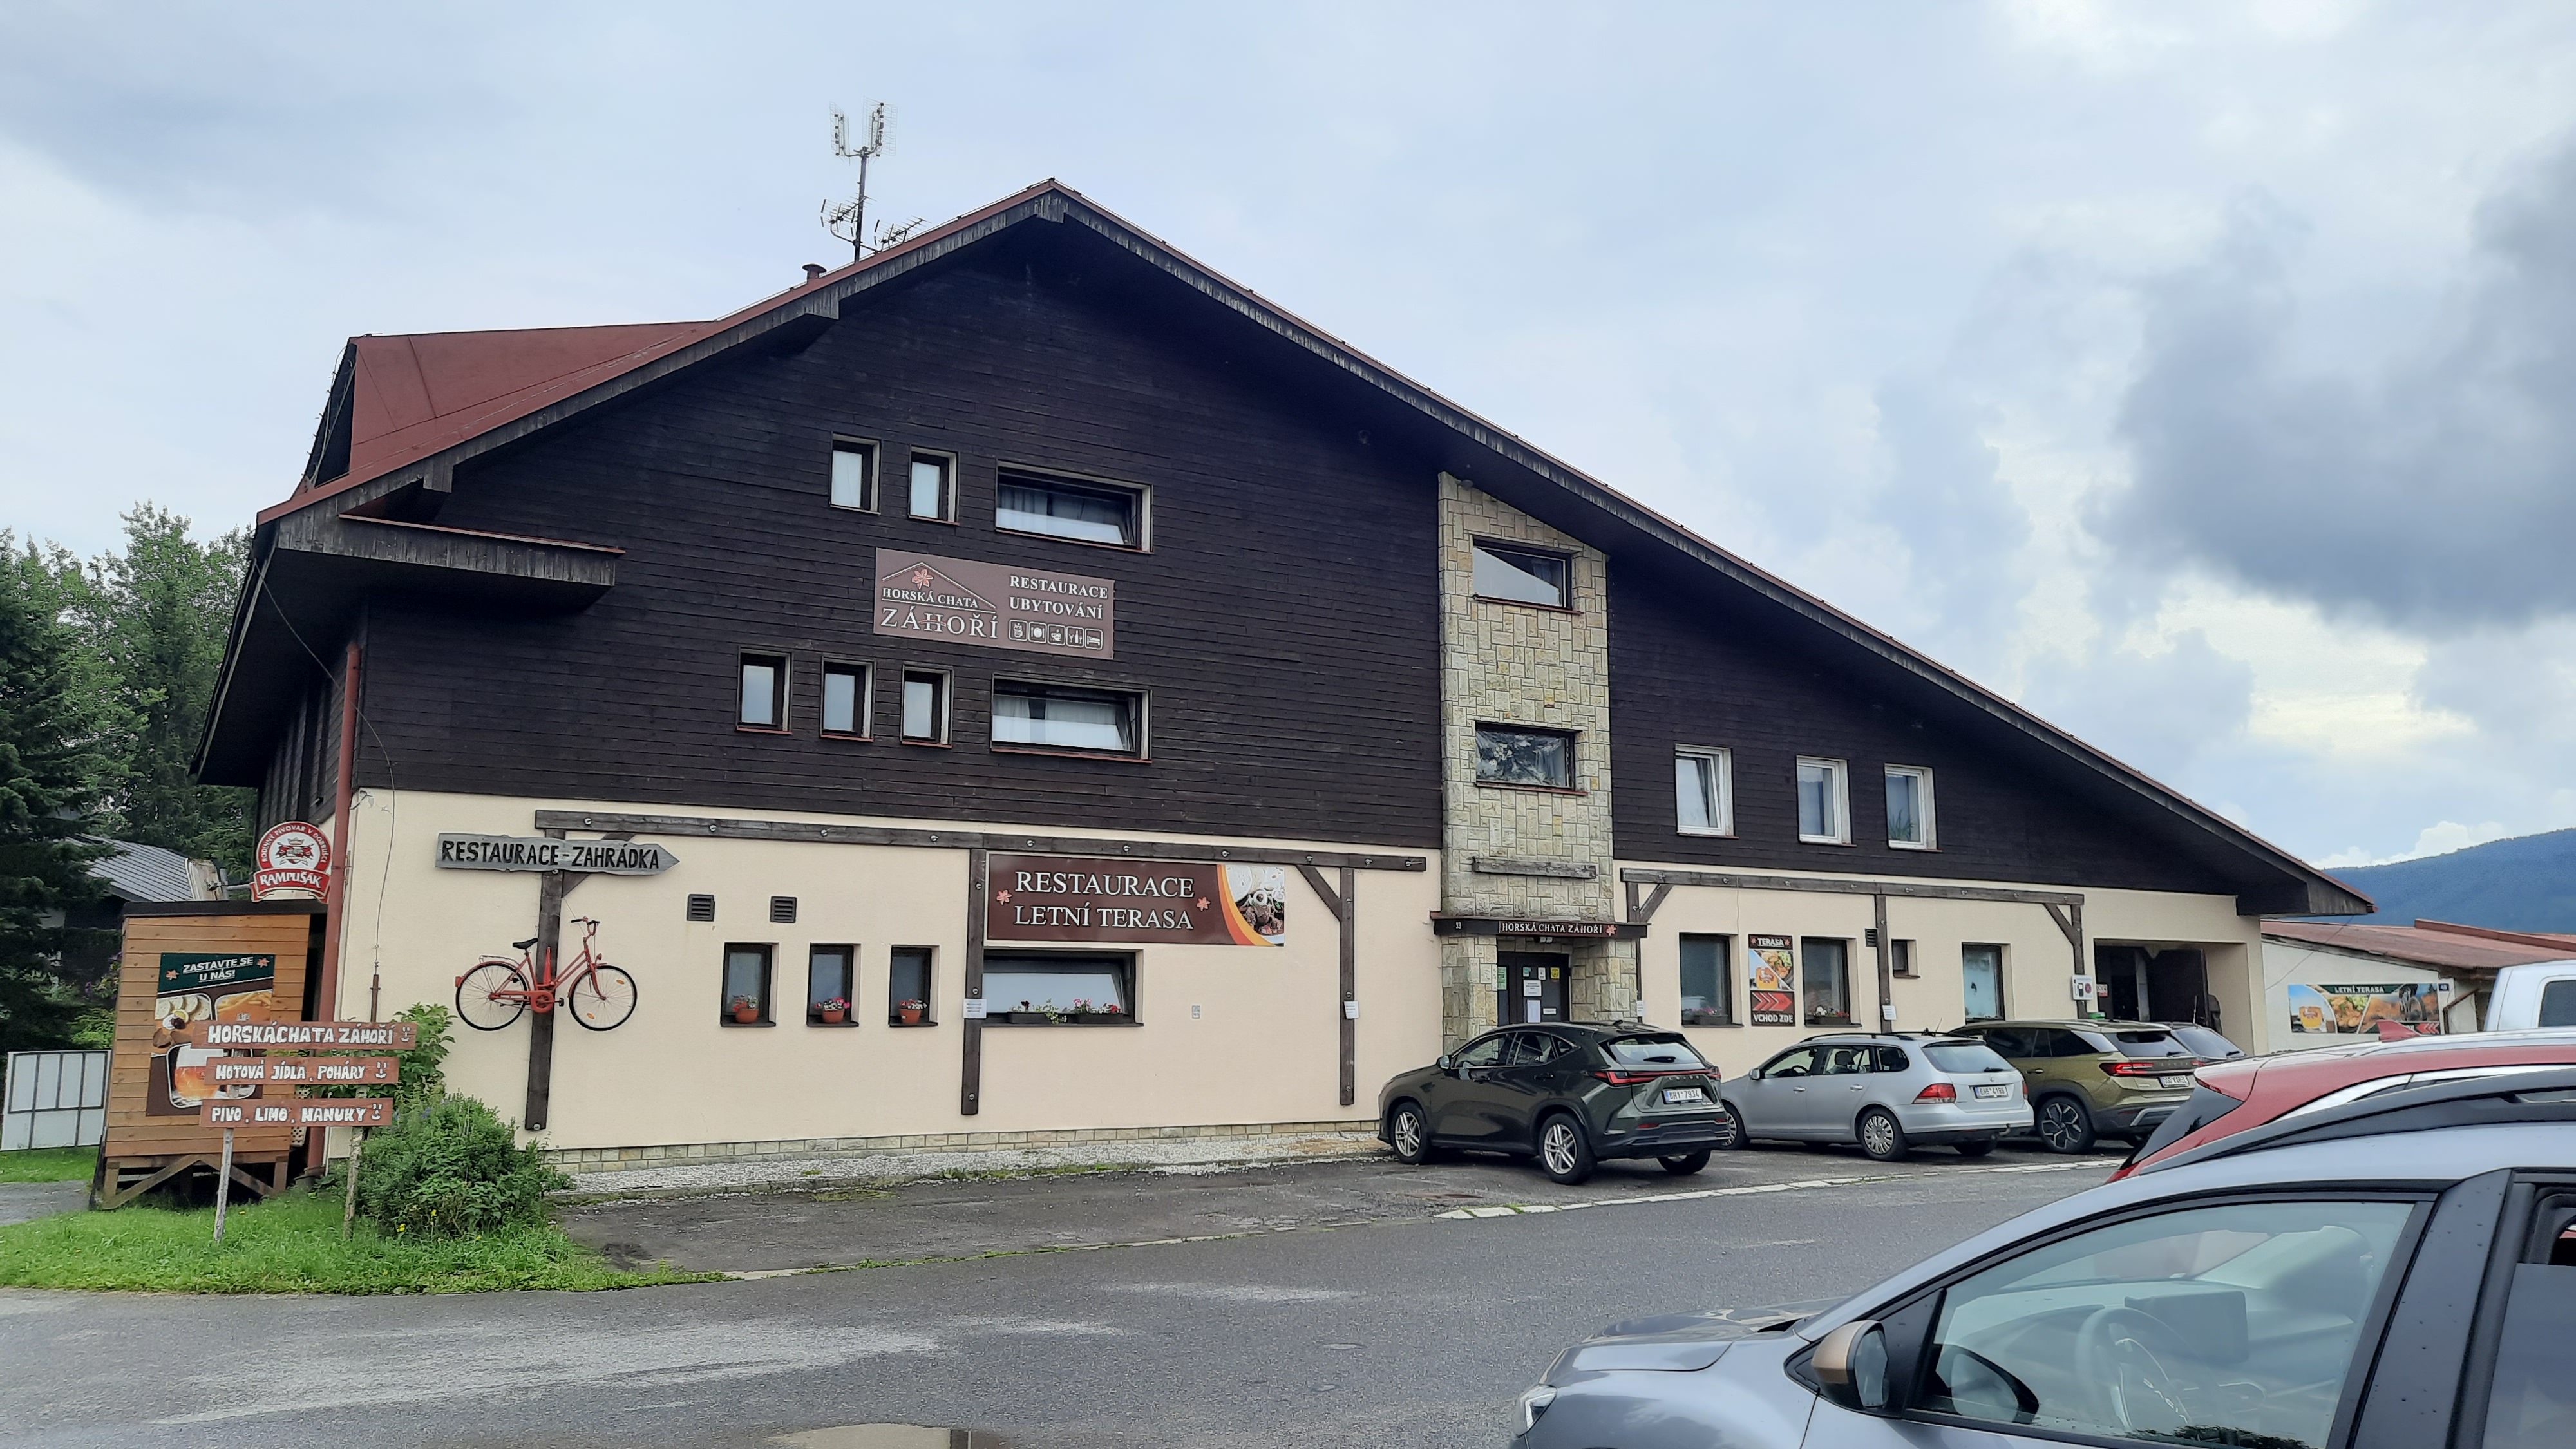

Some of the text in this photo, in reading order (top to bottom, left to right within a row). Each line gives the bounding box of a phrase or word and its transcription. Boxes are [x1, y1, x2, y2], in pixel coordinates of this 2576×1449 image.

[1009, 575, 1108, 599] RESTAURACE
[882, 587, 978, 609] HORSKÁ CHATA
[1009, 596, 1103, 620] UBYTOVÁNÍ
[880, 606, 998, 638] ZÁHOŘÍ
[259, 871, 323, 889] RAMPUŠÁK
[1014, 871, 1195, 898] RESTAURACE
[1014, 902, 1194, 929] LETNÍ TERASA
[1502, 922, 1603, 934] HORSKÁ CHATA ZÁHOŘÍ
[1757, 937, 1785, 947] TERASA
[182, 956, 254, 973] ZASTAVTE SE
[198, 967, 236, 981] U NÁS!
[2334, 985, 2356, 994] LETNÍ
[1753, 1013, 1794, 1023] VCHOD ZDE
[337, 1023, 394, 1045] ZÁHOŘÍ
[215, 1059, 265, 1080] HOTOVÁ
[317, 1060, 366, 1080] POHÁRY
